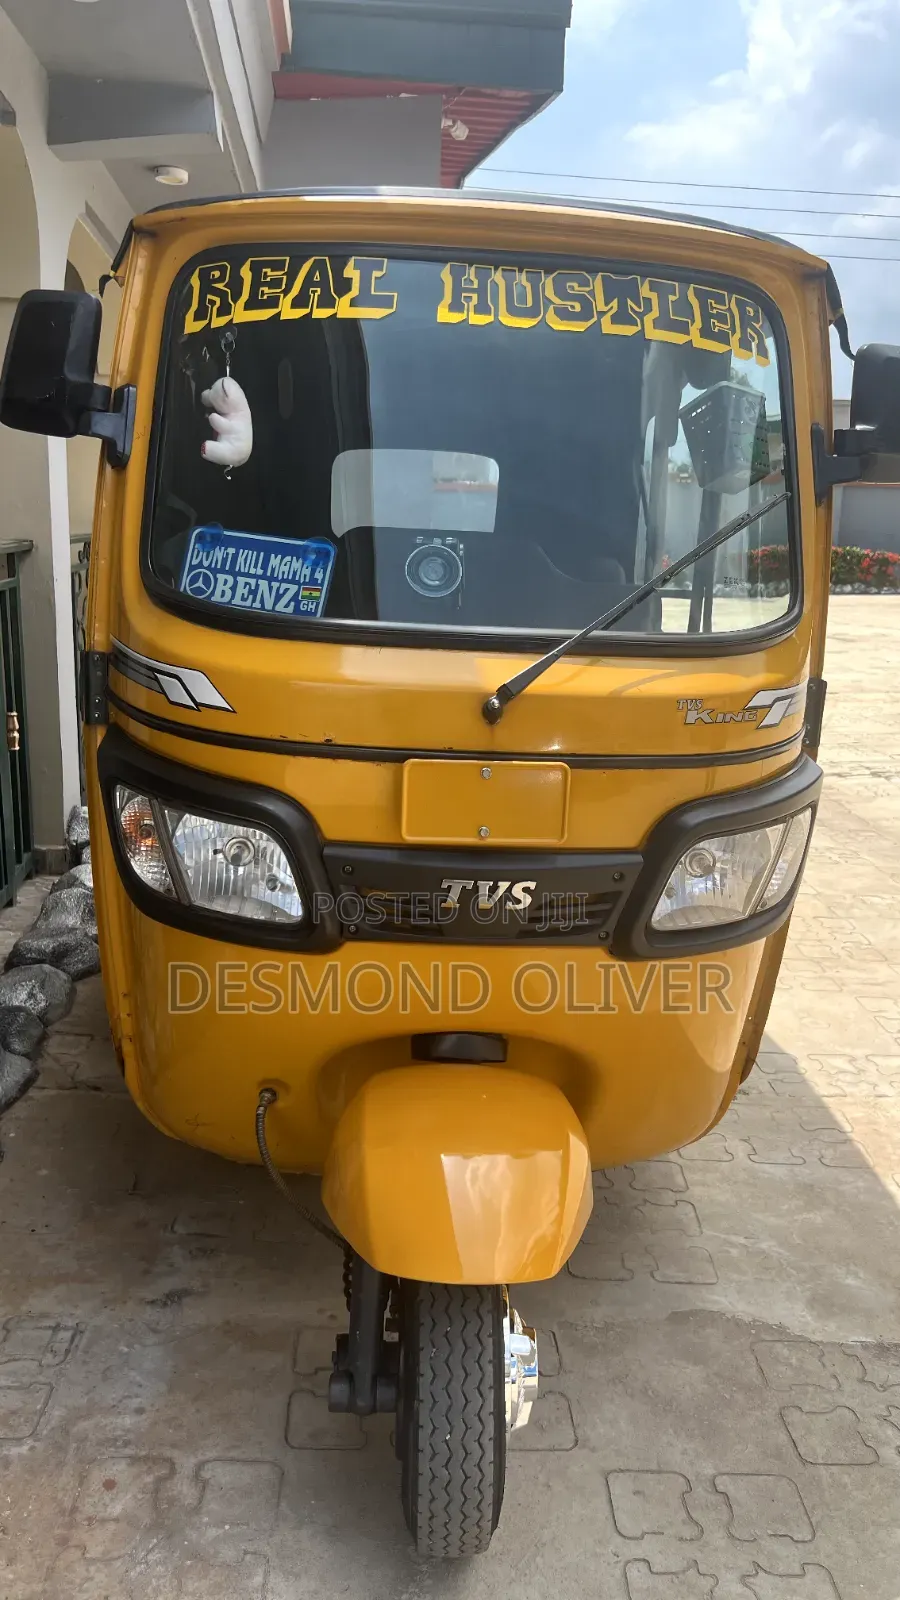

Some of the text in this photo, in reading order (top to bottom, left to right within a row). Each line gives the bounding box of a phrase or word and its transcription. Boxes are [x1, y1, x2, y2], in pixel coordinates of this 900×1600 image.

[183, 256, 771, 367] REAL HUSTLER
[191, 544, 235, 571] DON'T
[235, 548, 265, 576] KILL
[314, 562, 324, 584] 4
[211, 573, 299, 614] BENZ
[300, 601, 317, 613] GH
[677, 699, 703, 710] TVS
[440, 878, 537, 910] TVS
